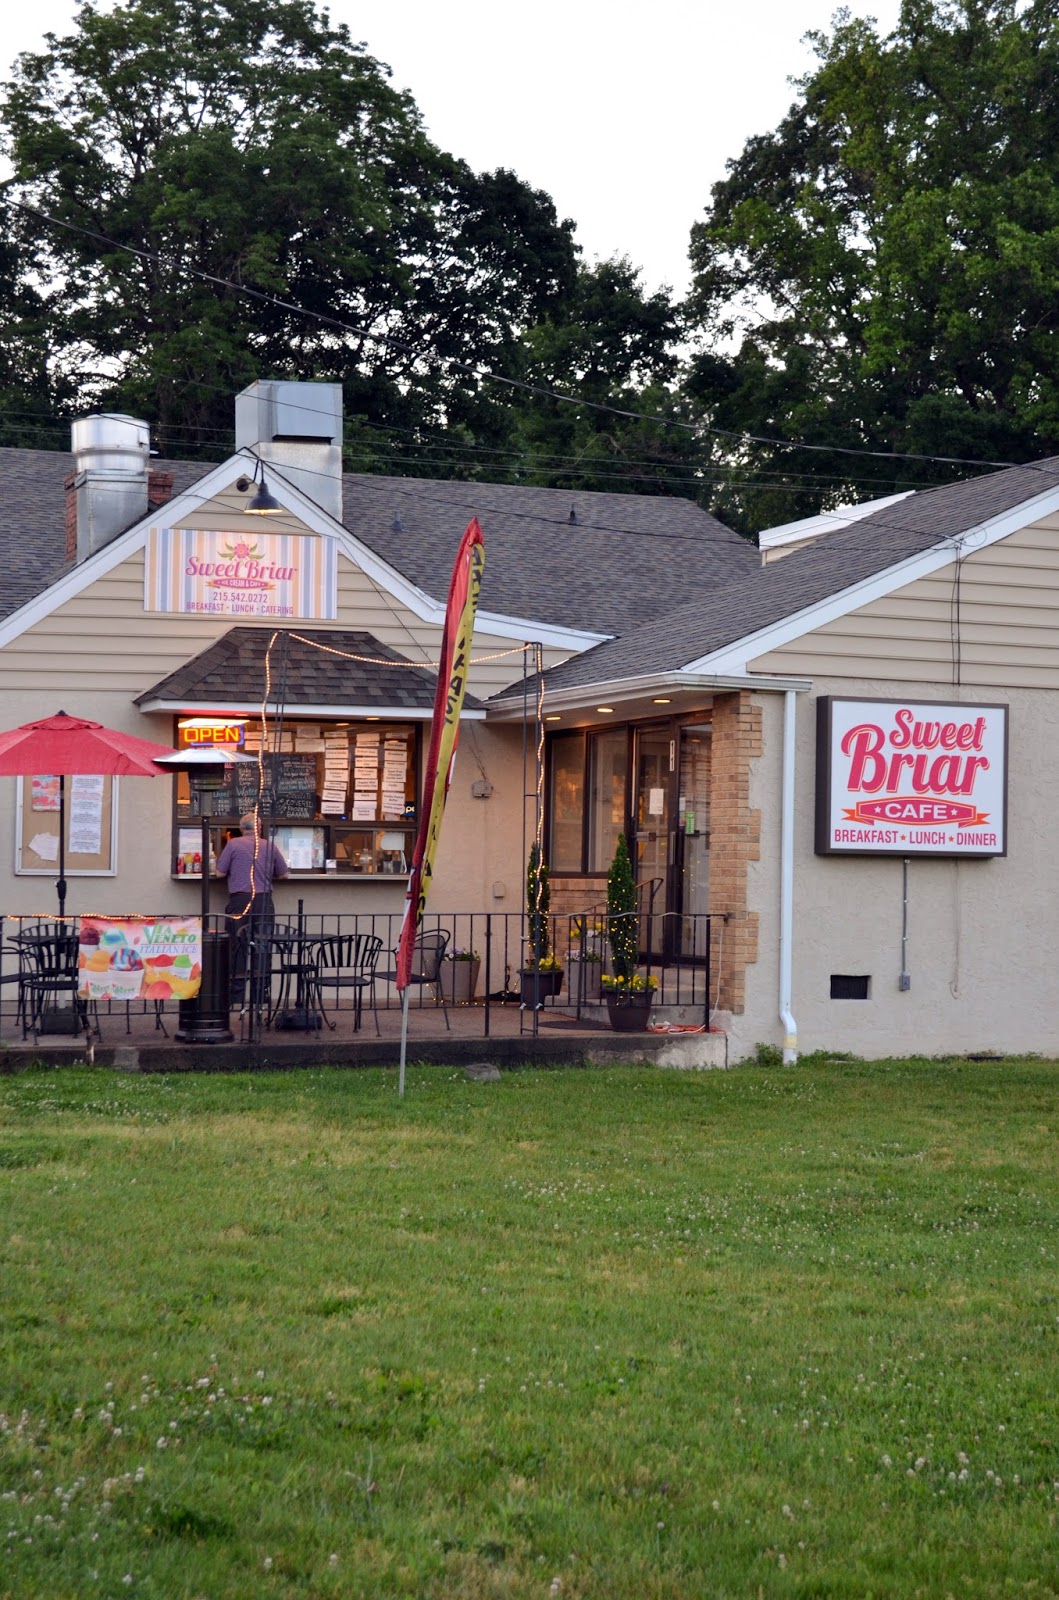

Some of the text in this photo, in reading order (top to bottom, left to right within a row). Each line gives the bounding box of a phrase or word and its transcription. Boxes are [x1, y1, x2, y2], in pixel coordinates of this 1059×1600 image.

[185, 556, 298, 581] Sweet Briar
[229, 579, 245, 587] CREAM
[213, 591, 268, 603] 215.542.0272
[186, 601, 294, 614] BREAKFAST LUNCH CATERING
[184, 727, 239, 742] OPEN
[889, 708, 986, 751] Sweet
[841, 723, 990, 796] Briar
[884, 803, 948, 820] CAFE
[834, 829, 997, 847] BREAKFAST LUNCH DINNER
[140, 945, 198, 954] ITALIAN ICE
